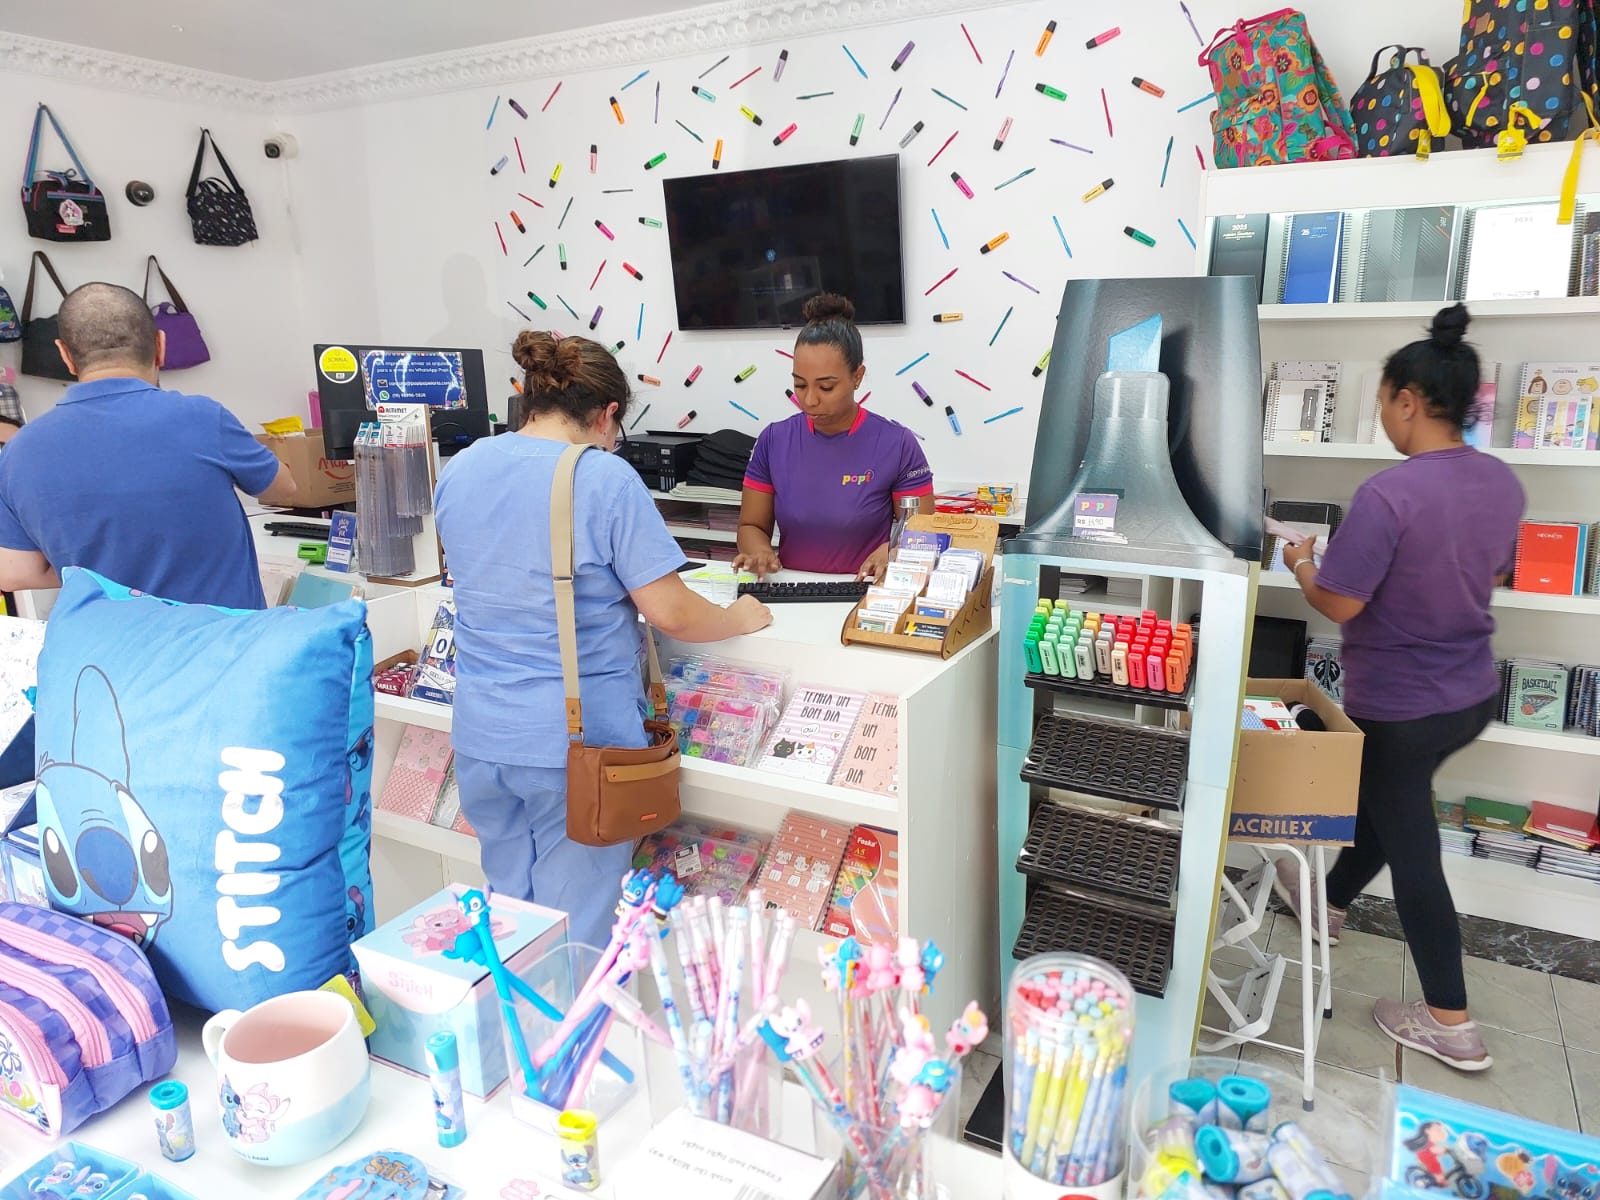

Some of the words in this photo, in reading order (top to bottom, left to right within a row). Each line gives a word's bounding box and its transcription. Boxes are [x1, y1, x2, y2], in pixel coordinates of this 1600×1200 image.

[841, 470, 873, 486] popi
[1521, 678, 1557, 693] BASKETBALL
[803, 690, 833, 707] TENHA
[835, 695, 851, 708] UM
[800, 706, 822, 720] BOM
[823, 709, 841, 723] DIA
[862, 723, 878, 738] UM
[853, 744, 878, 762] BOM
[845, 767, 864, 784] DIA
[1232, 818, 1313, 836] ACRILEX
[214, 746, 286, 972] STITCH
